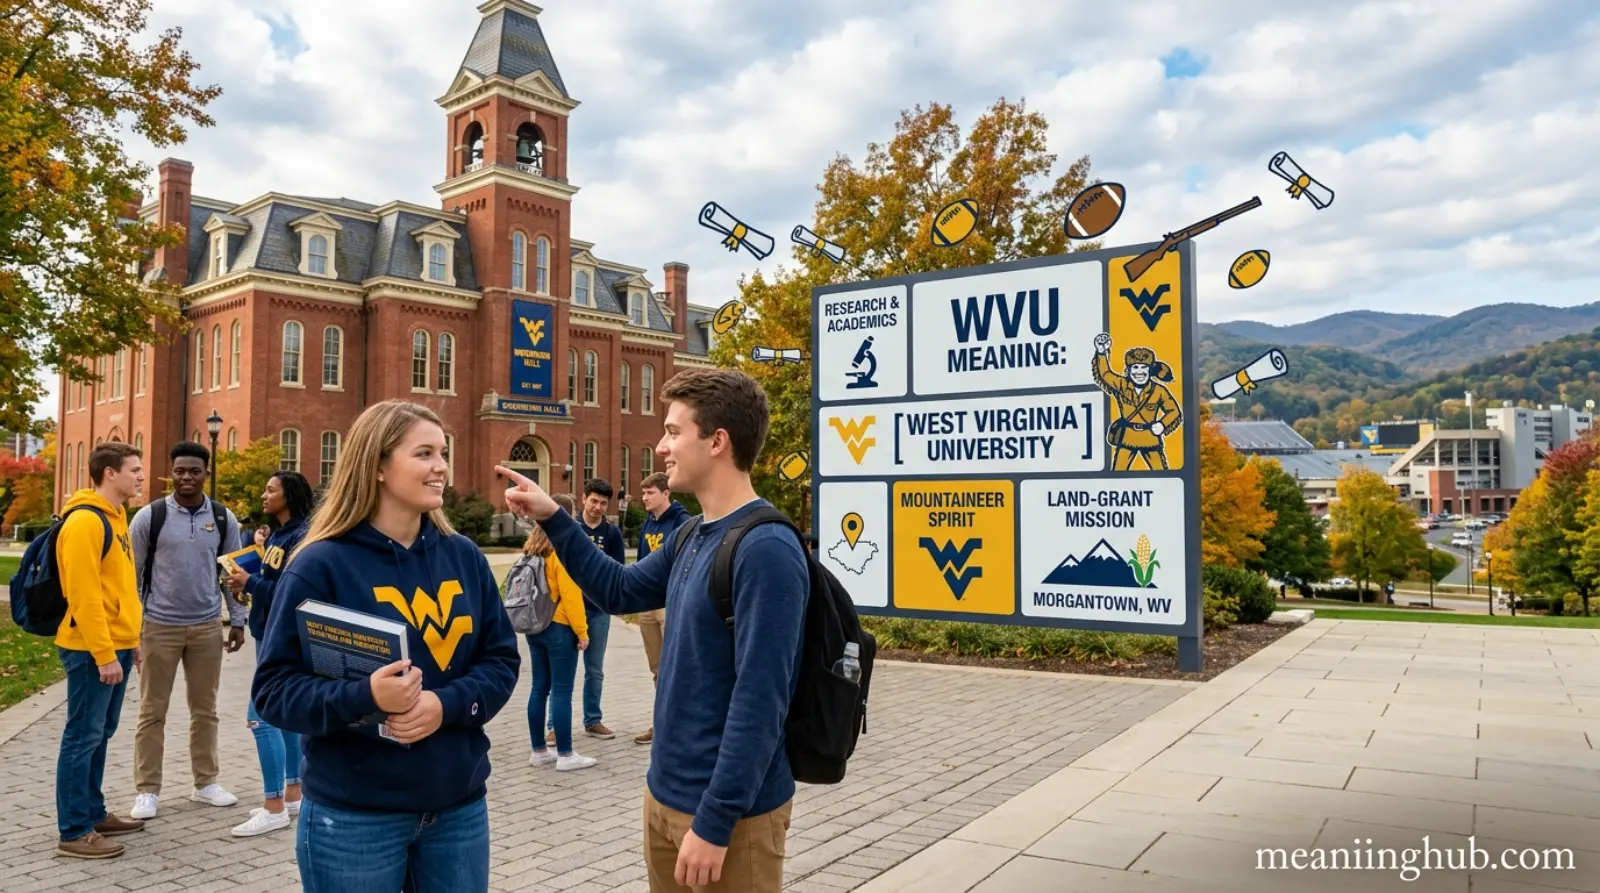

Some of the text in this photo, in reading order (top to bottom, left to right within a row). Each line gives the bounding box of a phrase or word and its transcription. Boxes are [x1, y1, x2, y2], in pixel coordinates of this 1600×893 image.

[825, 296, 900, 319] RESEARCH &
[949, 287, 1060, 344] WVU
[827, 312, 898, 333] ACADEMICS
[947, 340, 1067, 373] MEANING:
[927, 435, 1055, 462] UNIVERSITY
[901, 491, 1005, 508] MOUNTAINEER
[1047, 490, 1154, 507] LAND-GRANT
[928, 511, 976, 528] SPIRIT
[1065, 511, 1135, 528] MISSION
[1033, 592, 1172, 614] MORGANTOWN, WV
